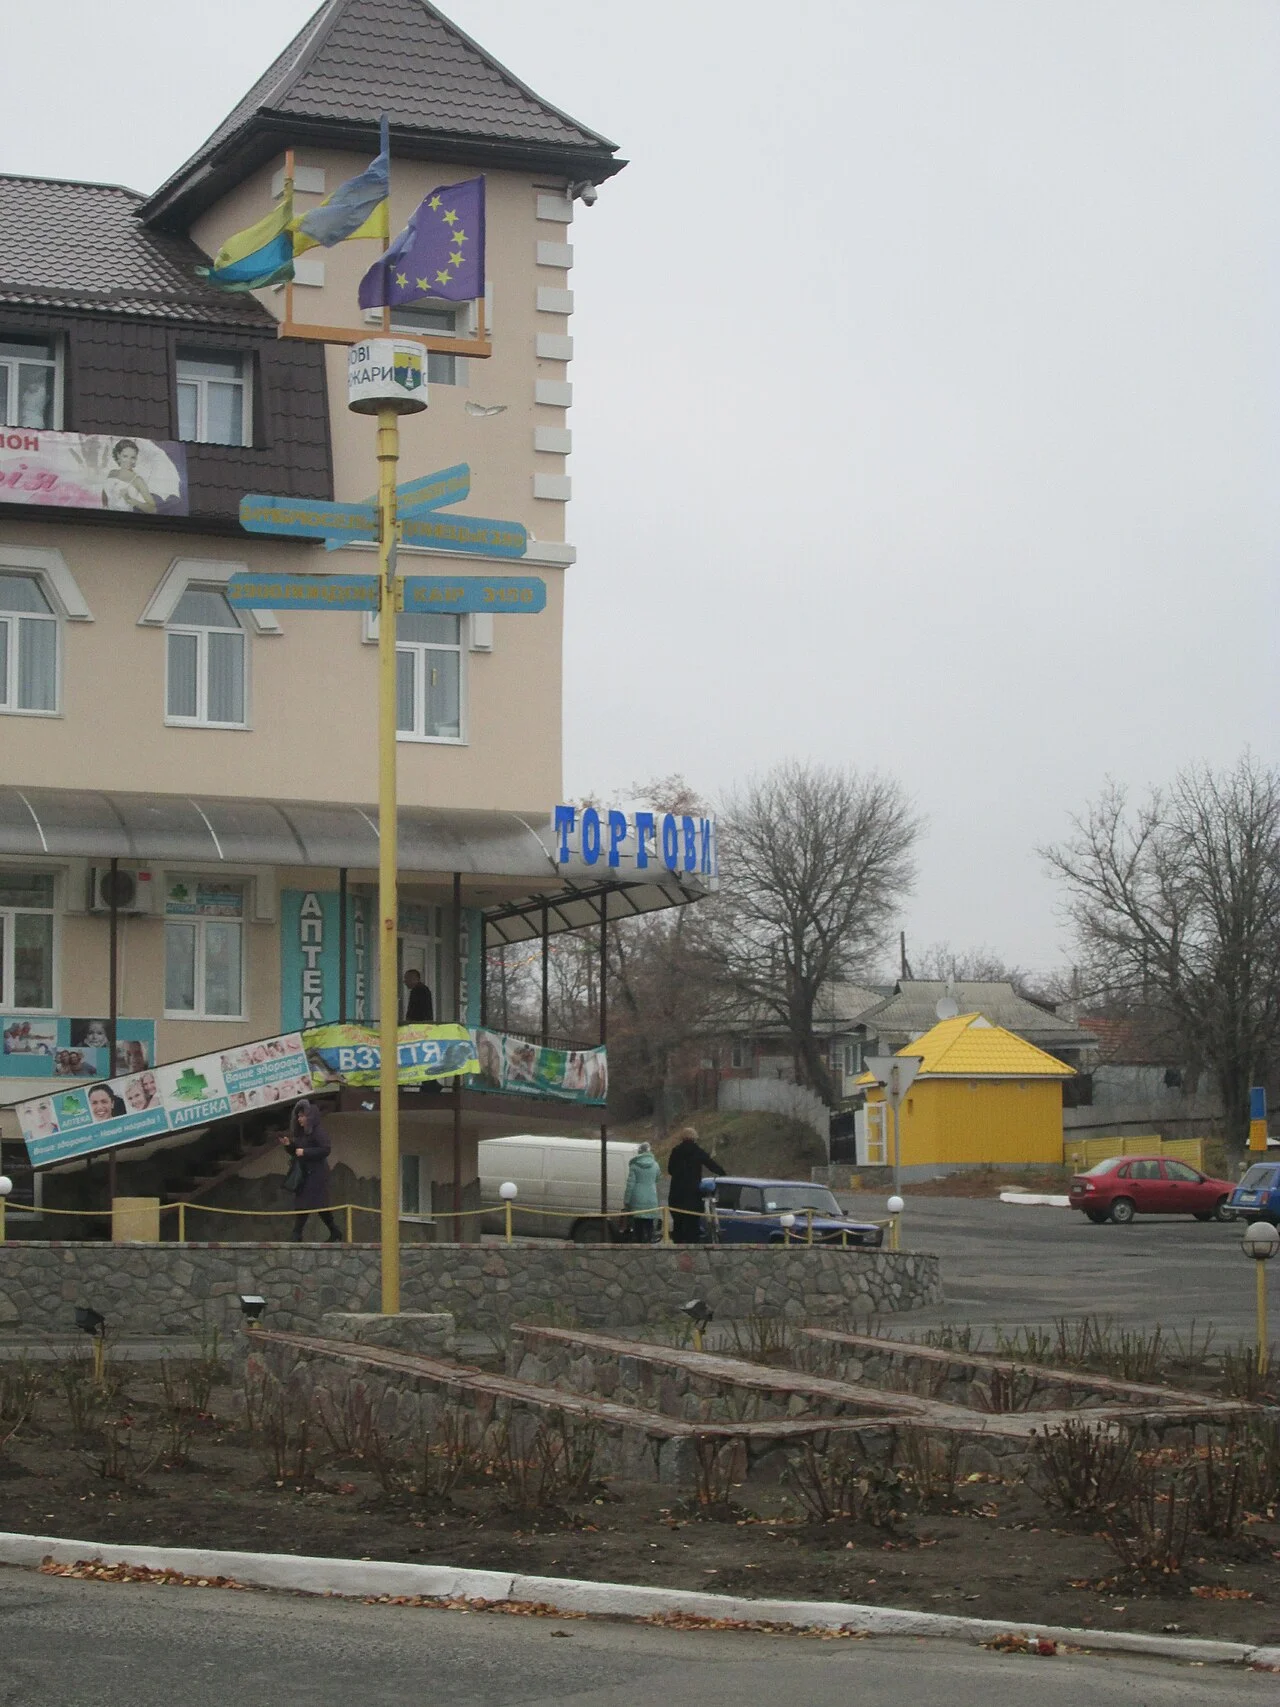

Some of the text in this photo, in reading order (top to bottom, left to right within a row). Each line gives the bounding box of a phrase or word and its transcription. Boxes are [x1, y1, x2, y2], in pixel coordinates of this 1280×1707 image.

[348, 346, 370, 365] ОВІ
[554, 805, 718, 876] ТОРГОВИ
[355, 896, 365, 1024] АПТЕК
[225, 1068, 254, 1083] Ваше
[62, 1114, 92, 1128] АПТЕКА
[174, 1099, 229, 1124] АПТЕКА
